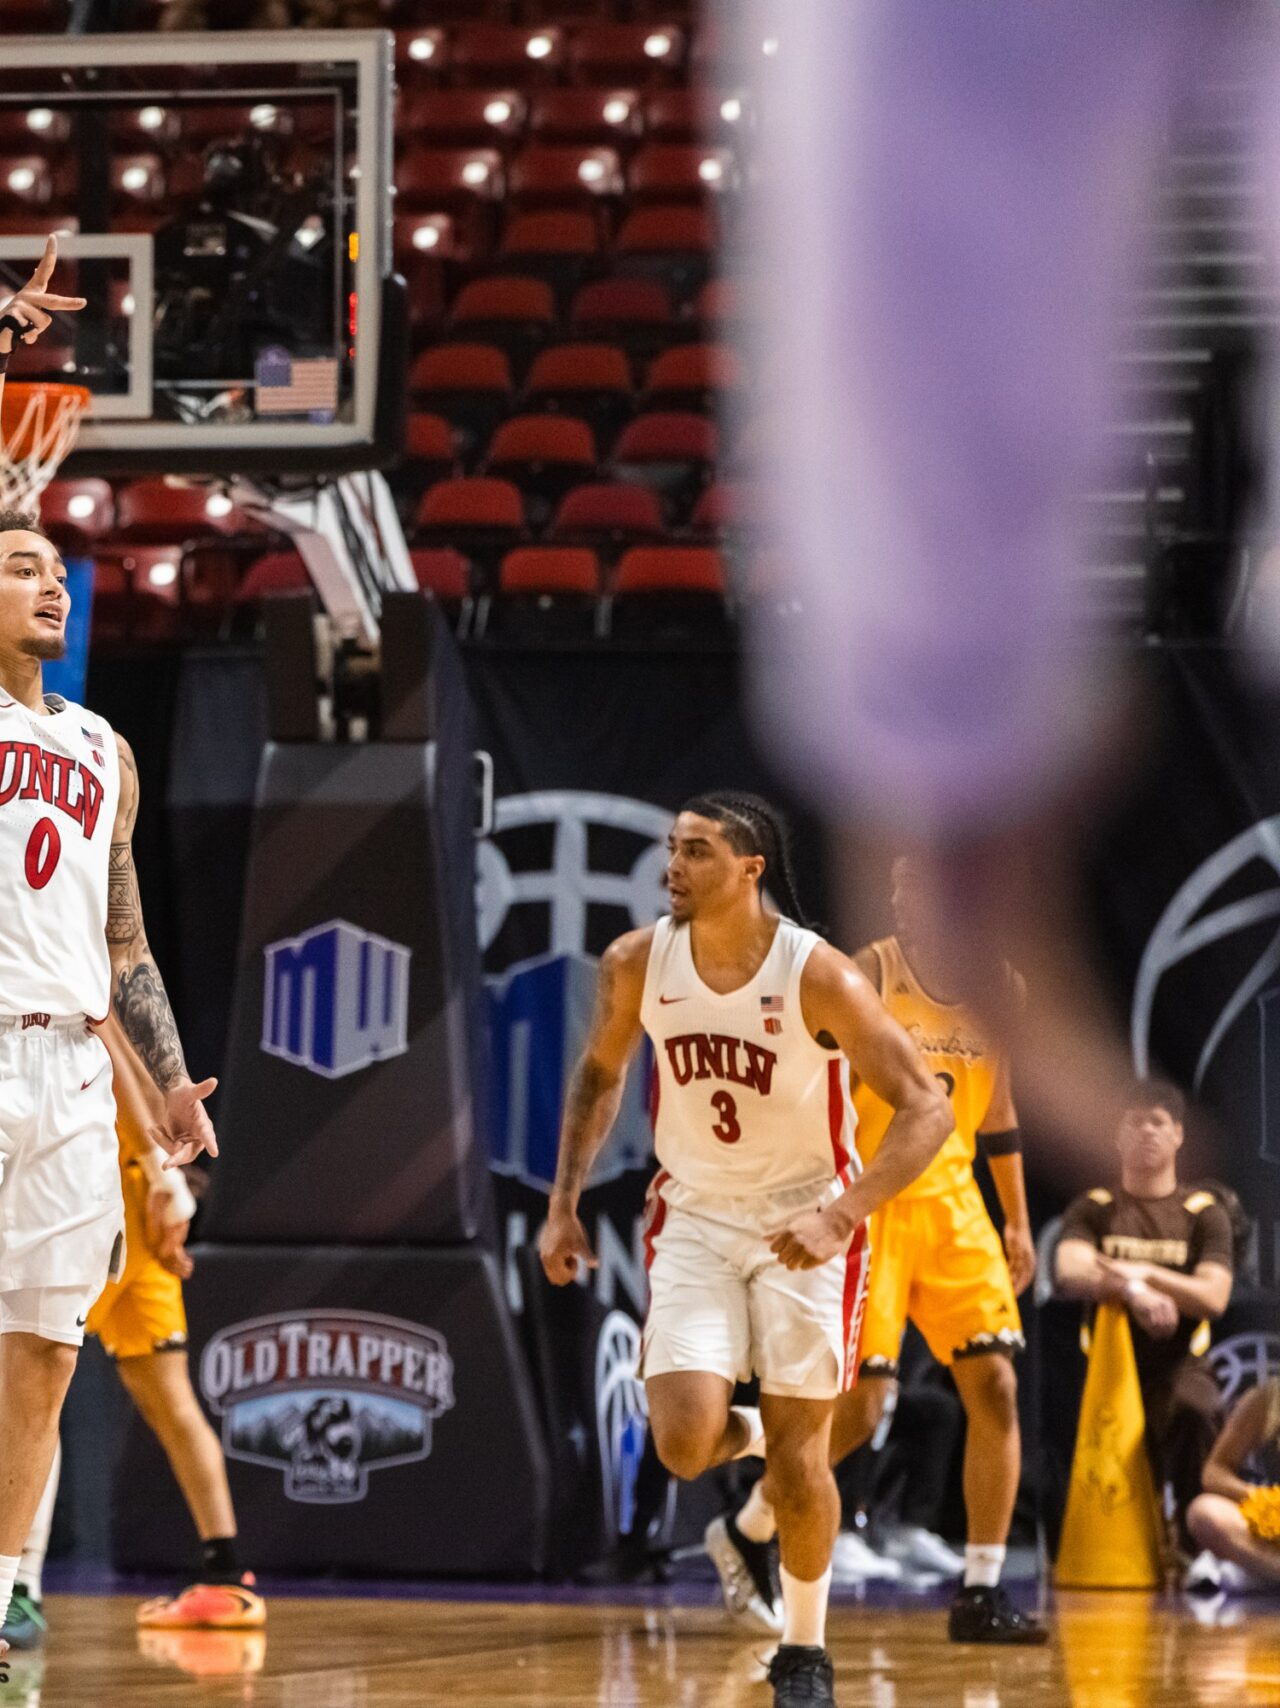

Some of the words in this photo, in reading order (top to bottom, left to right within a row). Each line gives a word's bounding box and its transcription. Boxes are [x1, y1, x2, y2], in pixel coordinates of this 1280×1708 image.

[24, 816, 62, 890] 0
[20, 1011, 52, 1030] UNLV
[664, 1032, 777, 1096] UNLV
[710, 1089, 742, 1144] 3
